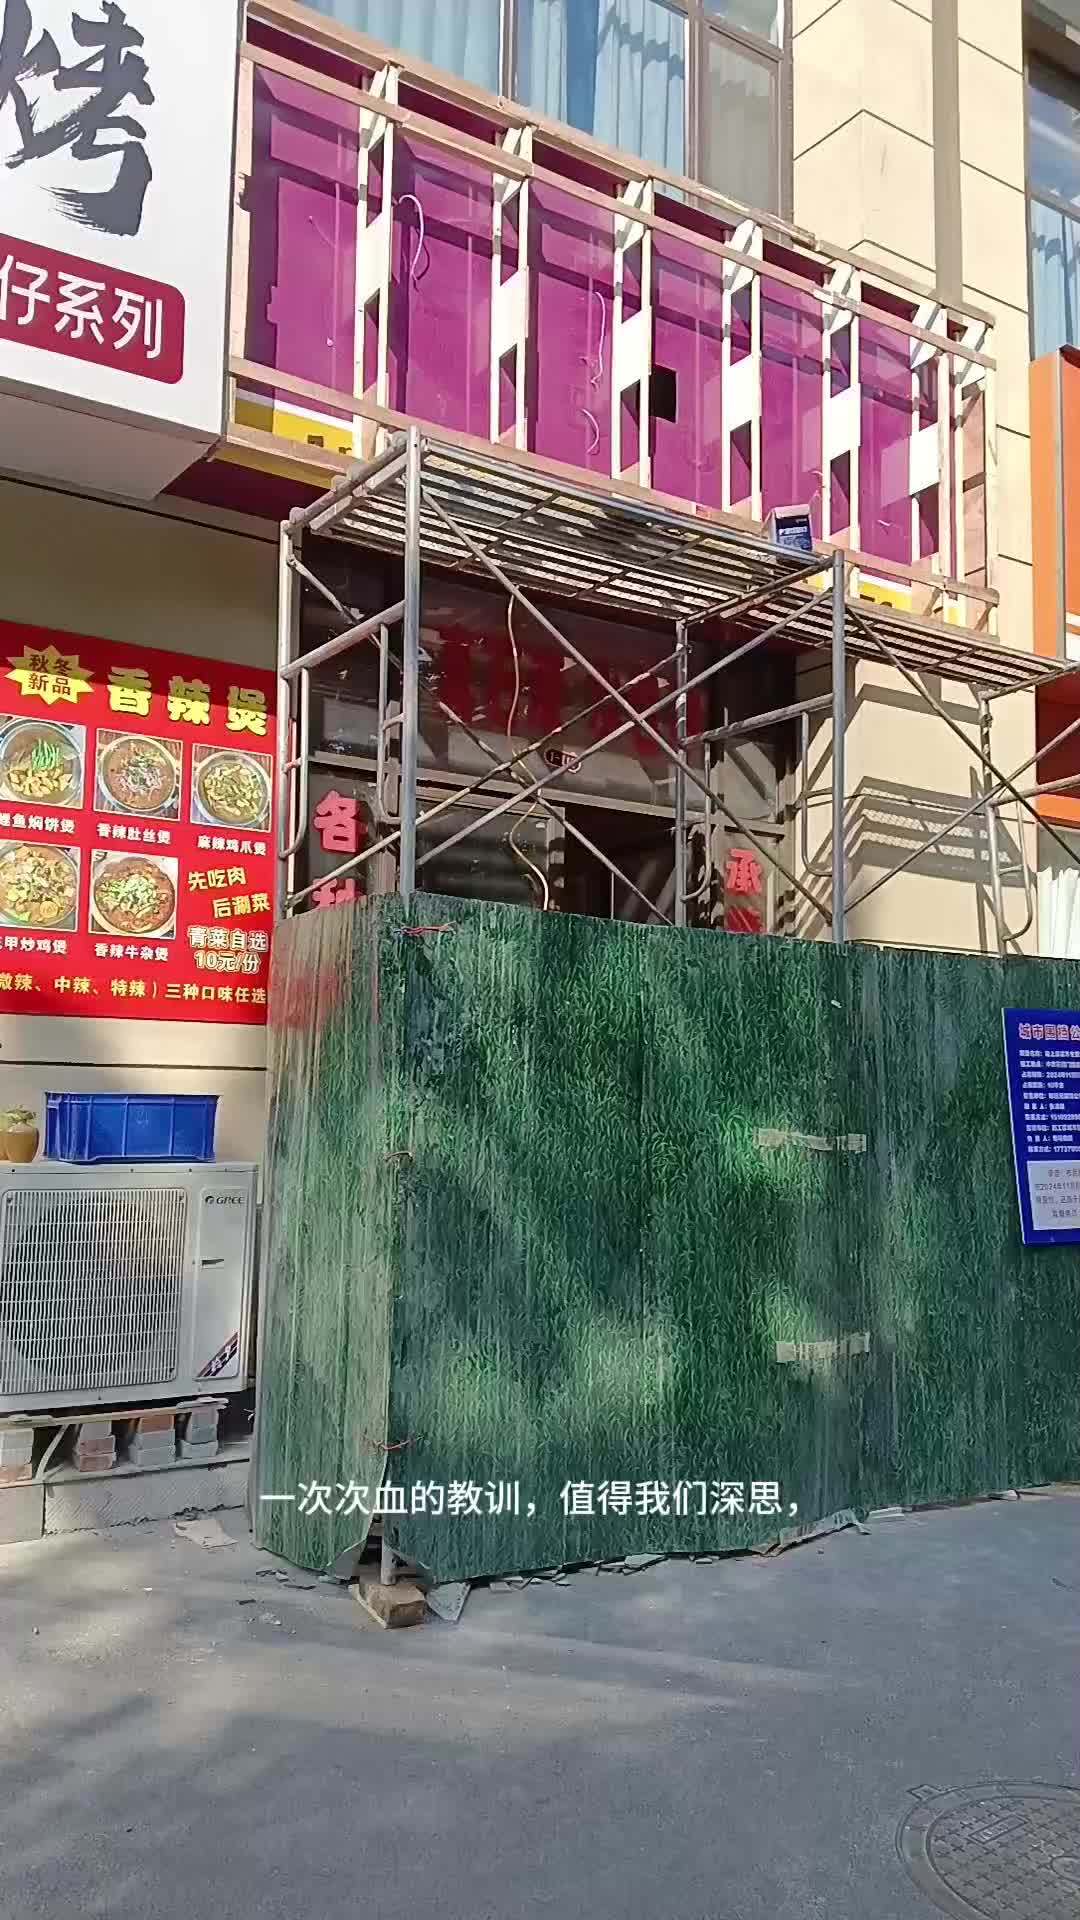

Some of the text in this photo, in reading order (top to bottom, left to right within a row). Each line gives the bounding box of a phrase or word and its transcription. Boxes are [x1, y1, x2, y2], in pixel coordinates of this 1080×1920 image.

[0, 255, 162, 358] 仔系列
[29, 654, 73, 676] 秋冬
[28, 673, 72, 697] 新品
[106, 666, 268, 736] 香辣煲
[188, 866, 247, 892] 先吃肉
[213, 893, 271, 918] 后涮菜
[0, 935, 67, 954] 甲炒鸡煲
[187, 925, 268, 952] 青菜自选
[94, 943, 169, 961] 香辣牛杂煲
[194, 950, 261, 974] 10元/份
